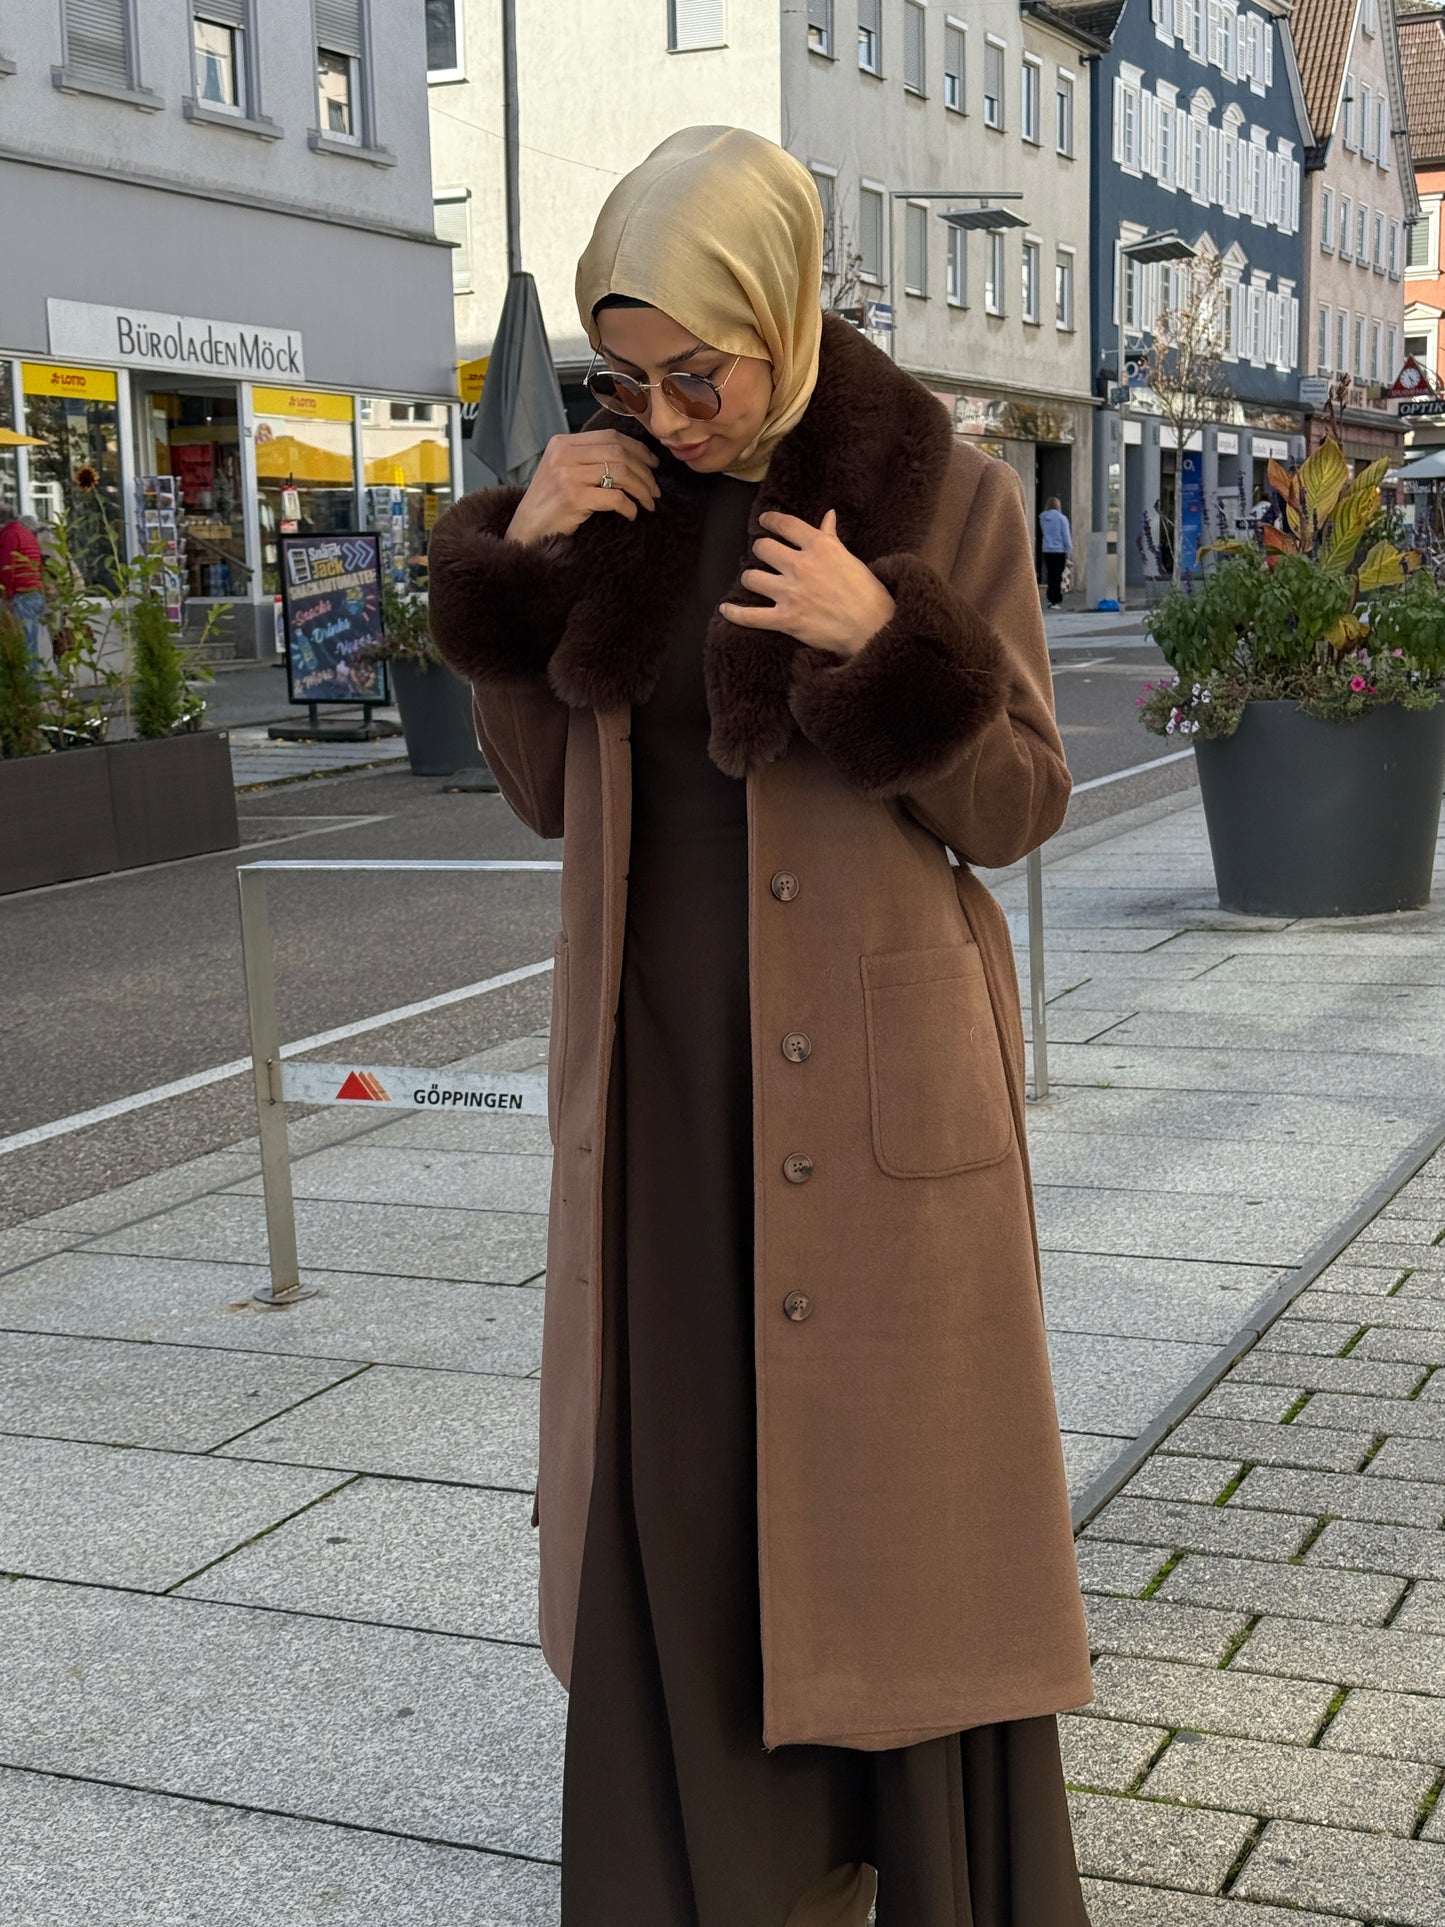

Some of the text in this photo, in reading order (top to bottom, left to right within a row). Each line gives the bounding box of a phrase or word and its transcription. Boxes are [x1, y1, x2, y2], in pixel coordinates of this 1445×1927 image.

[61, 374, 86, 386] LOTTO
[1400, 402, 1444, 415] OPTIK
[413, 1084, 523, 1109] GÖPPINGEN
